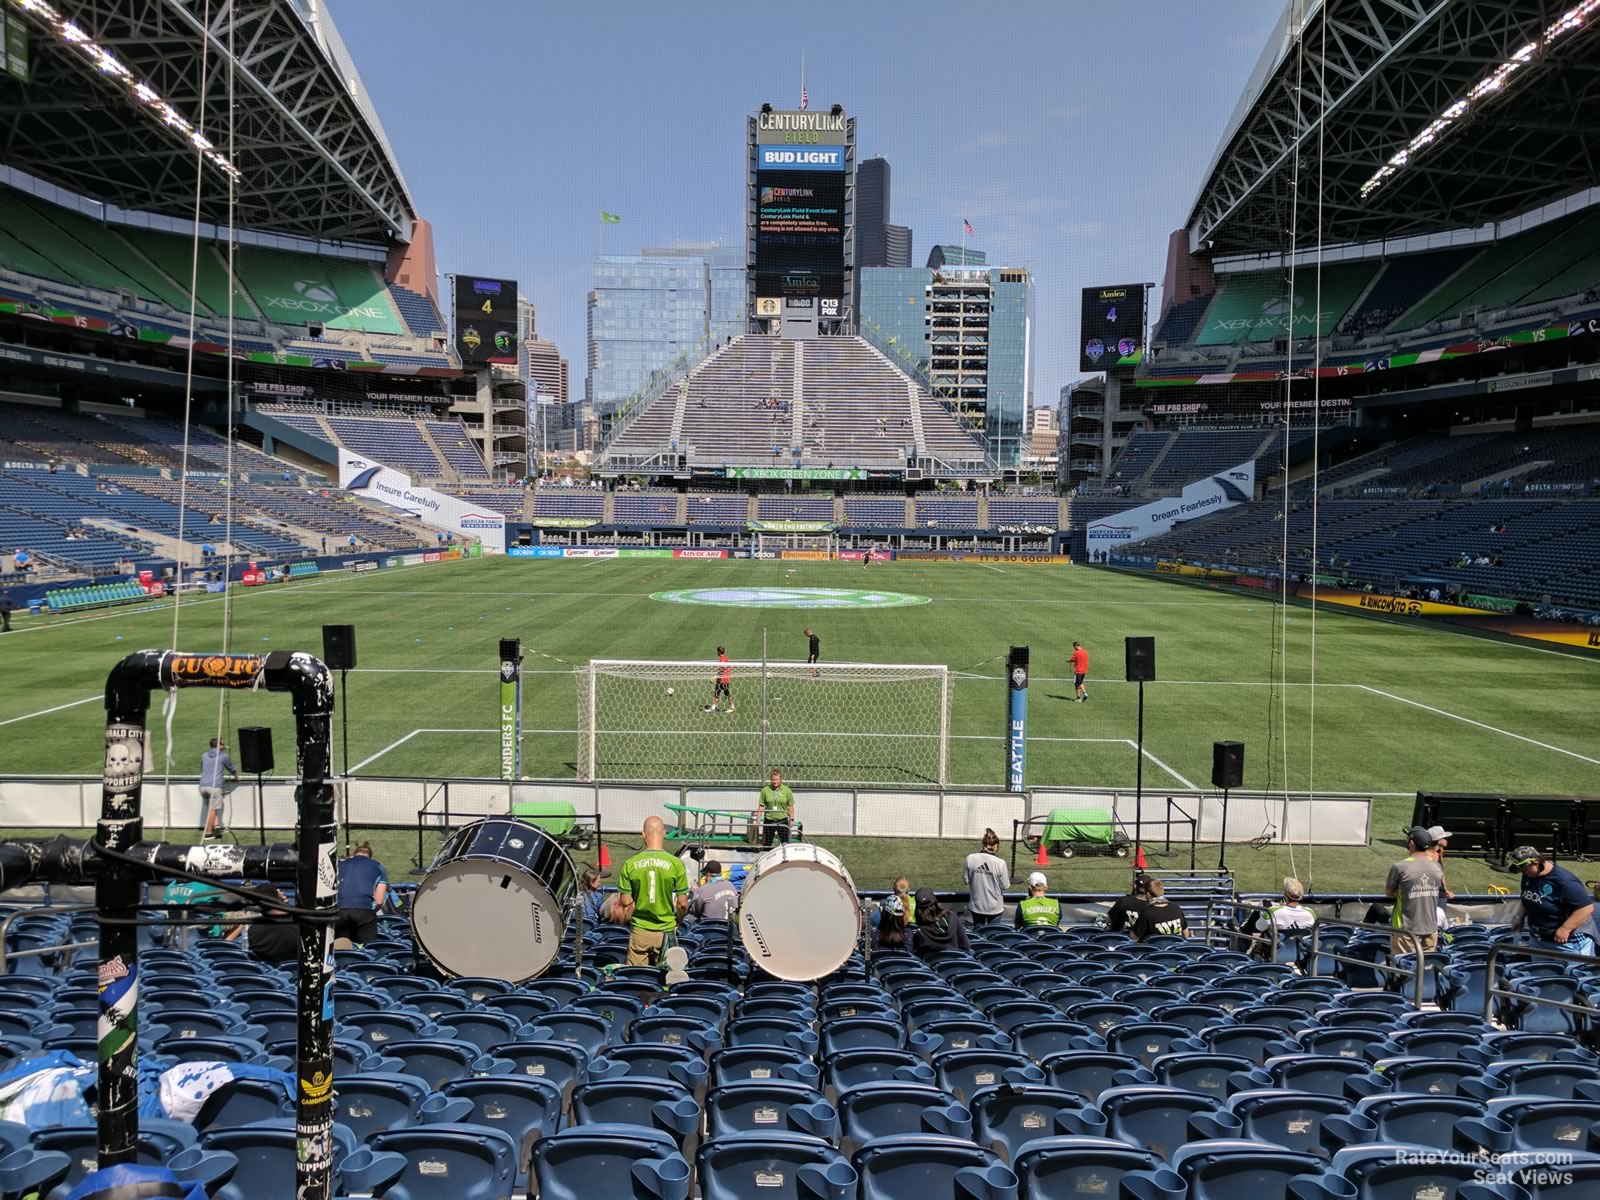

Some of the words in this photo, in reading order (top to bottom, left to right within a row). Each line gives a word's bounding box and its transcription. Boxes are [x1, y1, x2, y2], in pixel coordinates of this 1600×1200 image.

[760, 113, 844, 131] CENTURYLINK
[785, 132, 819, 143] FIELD
[764, 152, 795, 164] BUD
[797, 152, 838, 164] LIGHT
[774, 188, 814, 196] CENTURYLINK
[786, 276, 817, 286] Amica
[264, 295, 334, 314] XBOX
[338, 306, 386, 318] ONE
[482, 299, 492, 314] 4
[821, 299, 838, 307] Q13
[1107, 307, 1117, 322] 4
[74, 316, 88, 328] VS
[1214, 316, 1276, 330] XBOX
[1280, 312, 1335, 325] ONE
[1532, 330, 1546, 342] VS
[273, 354, 287, 364] VS
[1338, 366, 1348, 375] VS
[254, 382, 268, 391] THE
[269, 383, 285, 392] PRO
[286, 384, 306, 393] SHOP
[366, 392, 388, 400] YOUR
[389, 393, 423, 402] PREMIER
[1153, 404, 1166, 412] THE
[1167, 404, 1181, 412] PRO
[1284, 400, 1318, 408] PREMIER
[754, 470, 778, 479] XBOX
[780, 470, 811, 479] GREEN
[814, 470, 841, 479] ZONE
[376, 482, 402, 497] Insure
[404, 491, 440, 511] Carefully
[1151, 509, 1179, 522] Dream
[1181, 494, 1222, 514] Fearlessly
[1360, 596, 1366, 606] EL
[1367, 596, 1406, 614] RINCONSITO
[171, 658, 201, 673] CU
[234, 658, 260, 674] FC
[502, 704, 512, 720] FC
[128, 730, 143, 738] CITY
[633, 858, 671, 870] FIGHTNWIN
[648, 870, 656, 904] 1
[1026, 906, 1056, 914] RODRIGUEZ
